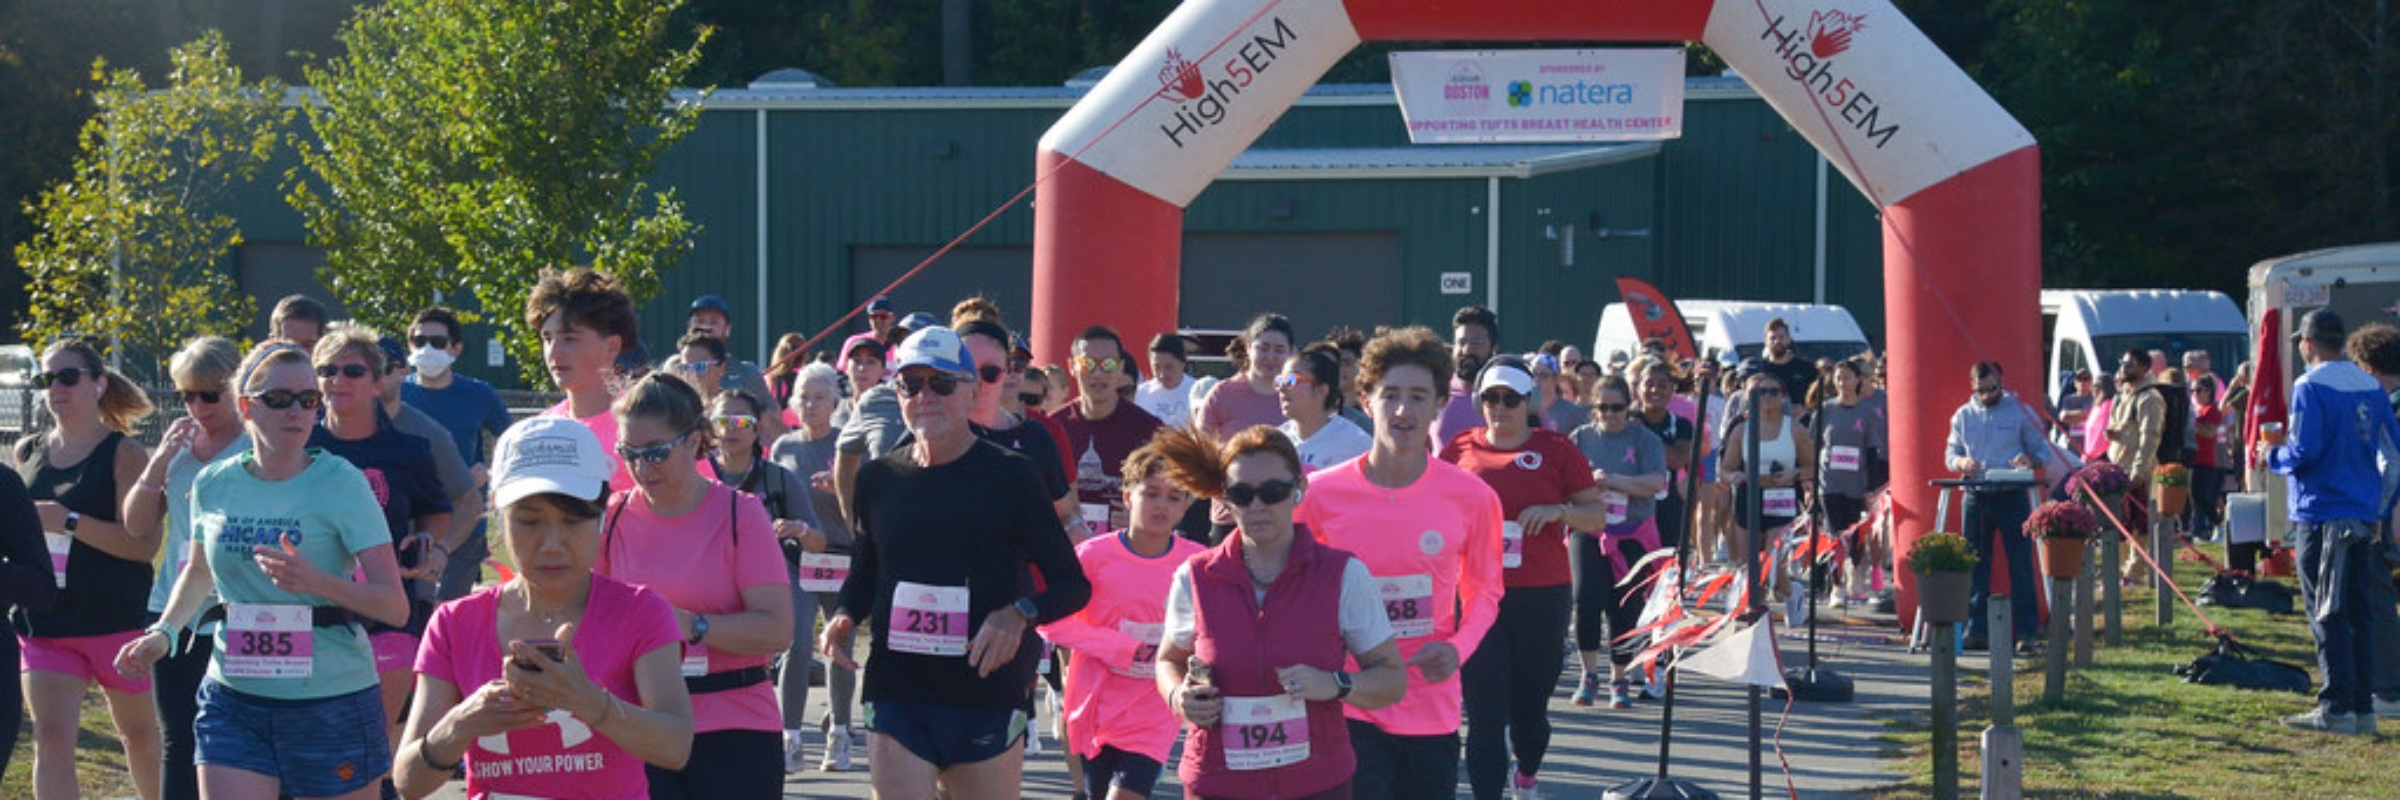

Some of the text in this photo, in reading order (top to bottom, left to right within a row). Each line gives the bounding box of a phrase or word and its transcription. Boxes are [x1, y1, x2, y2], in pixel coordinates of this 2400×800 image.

[1161, 17, 1297, 148] High5EM
[1444, 84, 1489, 99] BOSTON
[1540, 81, 1632, 104] natera
[1761, 16, 1899, 149] High5EM
[1408, 116, 1672, 130] UPPORTING TUFTS BREAST HEALTH CENTER
[1443, 276, 1469, 289] ONE
[257, 517, 300, 527] AMERICA
[219, 525, 303, 545] HICAGO
[907, 609, 949, 635] 231
[1387, 598, 1417, 622] 68
[241, 630, 293, 655] 385
[1240, 722, 1287, 749] 194
[475, 752, 604, 778] SHOW YOUR POWER
